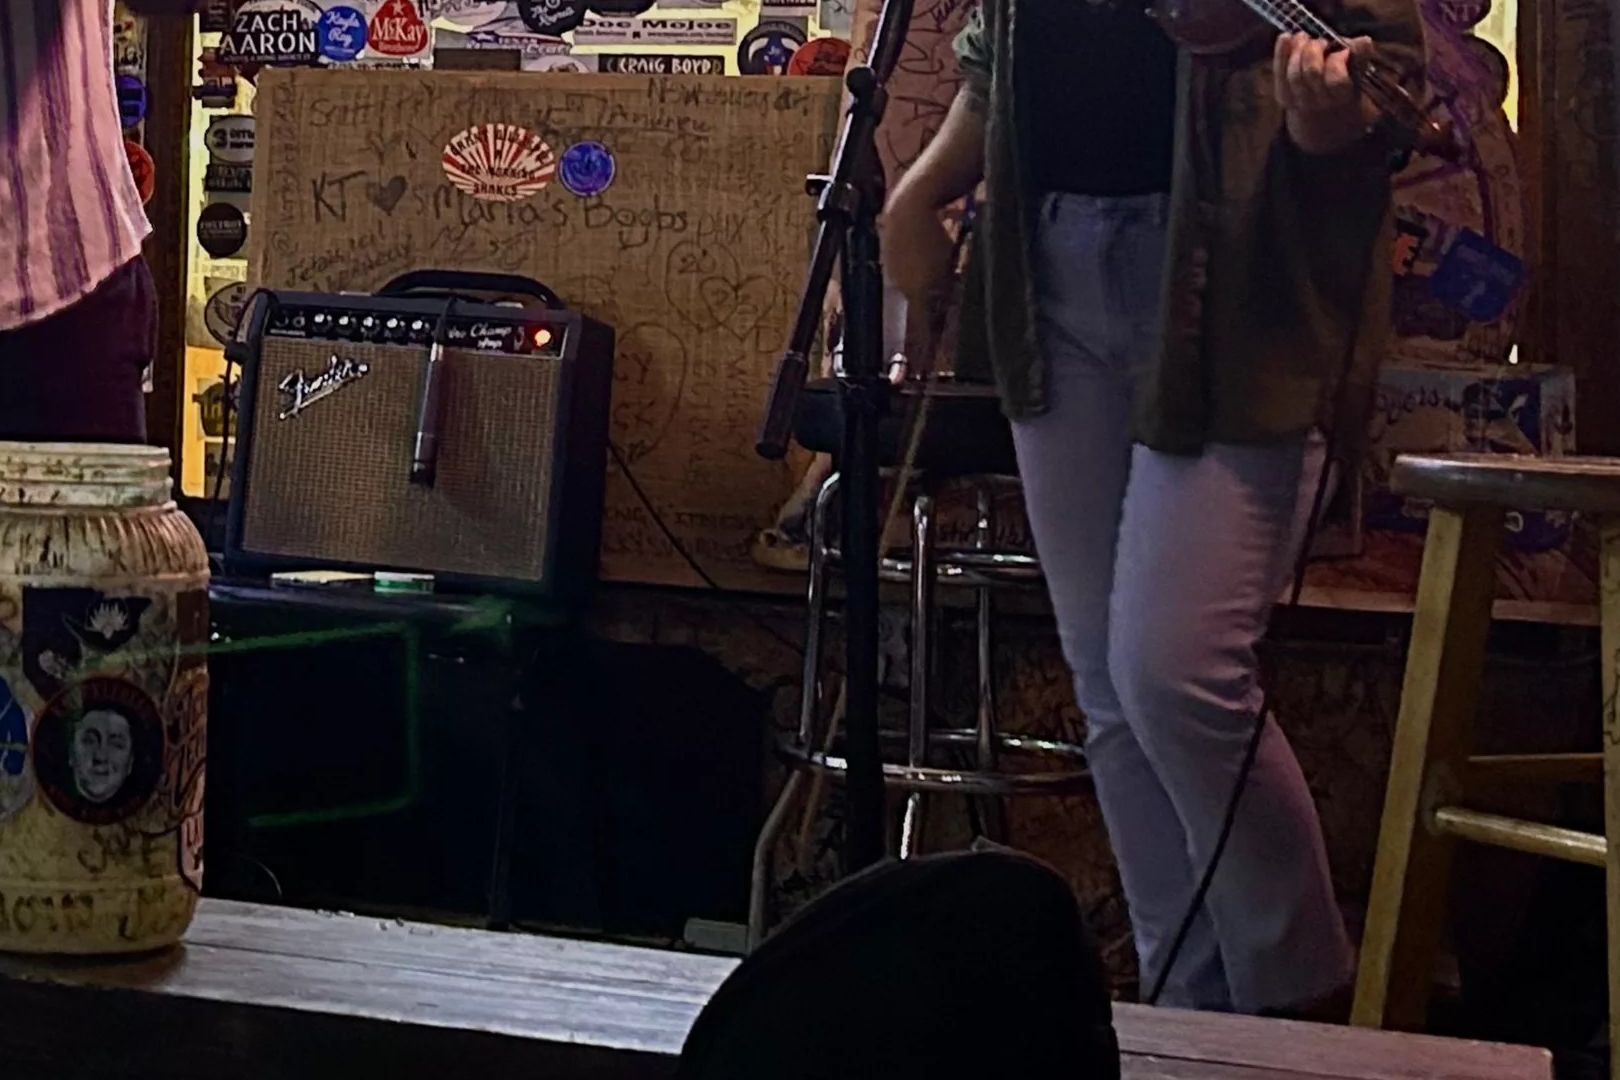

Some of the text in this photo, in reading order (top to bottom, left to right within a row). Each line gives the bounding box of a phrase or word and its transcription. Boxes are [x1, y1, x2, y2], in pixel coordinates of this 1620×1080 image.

[236, 13, 298, 33] ZACH
[219, 31, 316, 55] AARON
[474, 183, 517, 196] SHAKES
